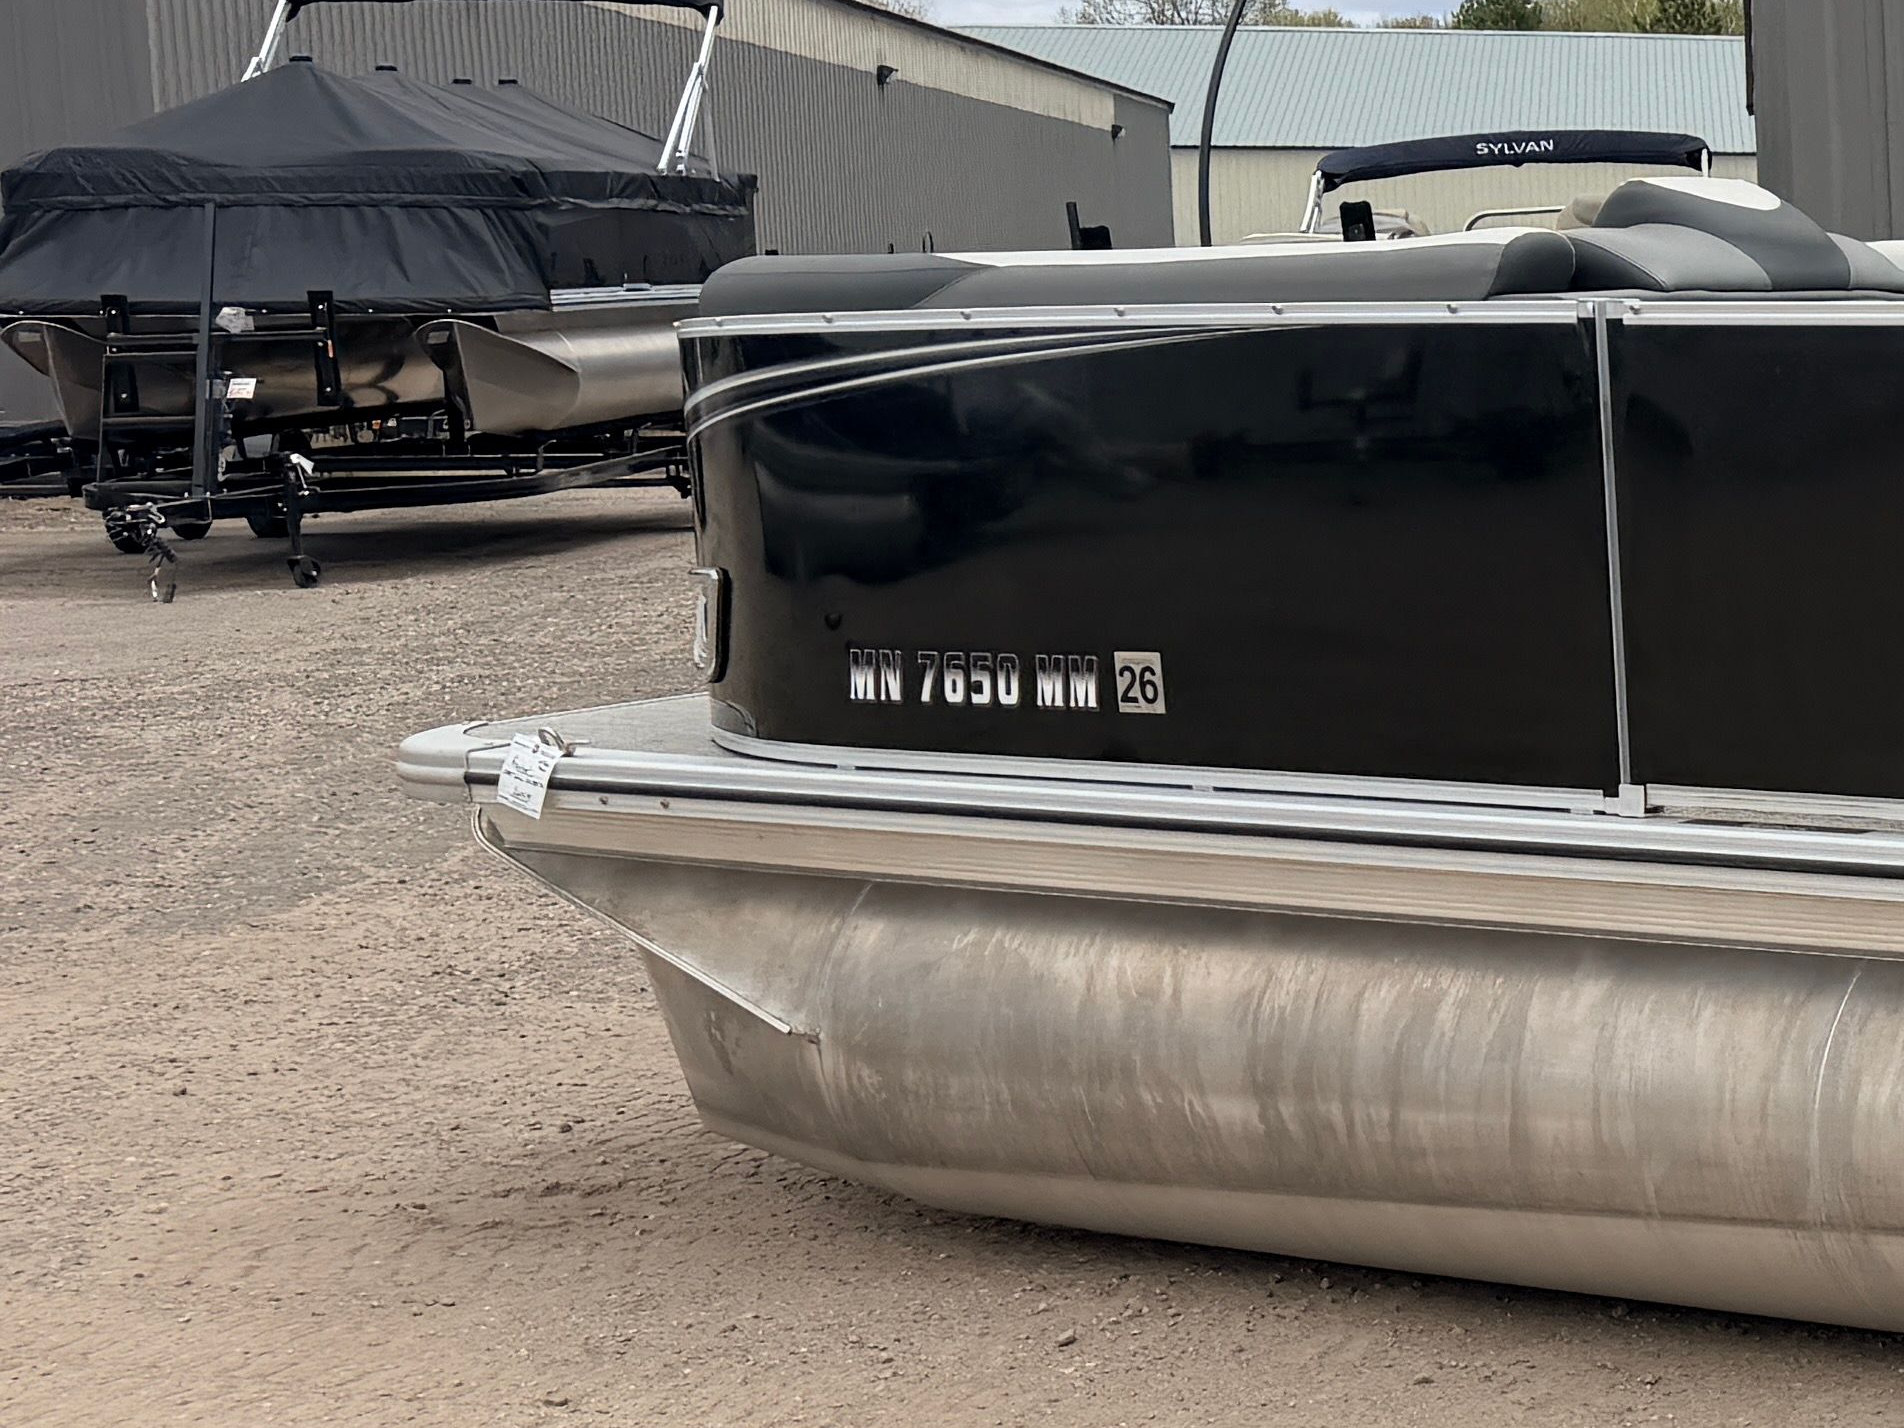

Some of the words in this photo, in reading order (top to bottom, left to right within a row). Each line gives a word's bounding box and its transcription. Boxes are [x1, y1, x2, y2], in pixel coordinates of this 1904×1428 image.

[1475, 138, 1554, 155] SYLVAN
[849, 648, 902, 702] MN
[917, 650, 1021, 707] 7650
[1035, 653, 1099, 710] MM
[1118, 664, 1160, 705] 26
